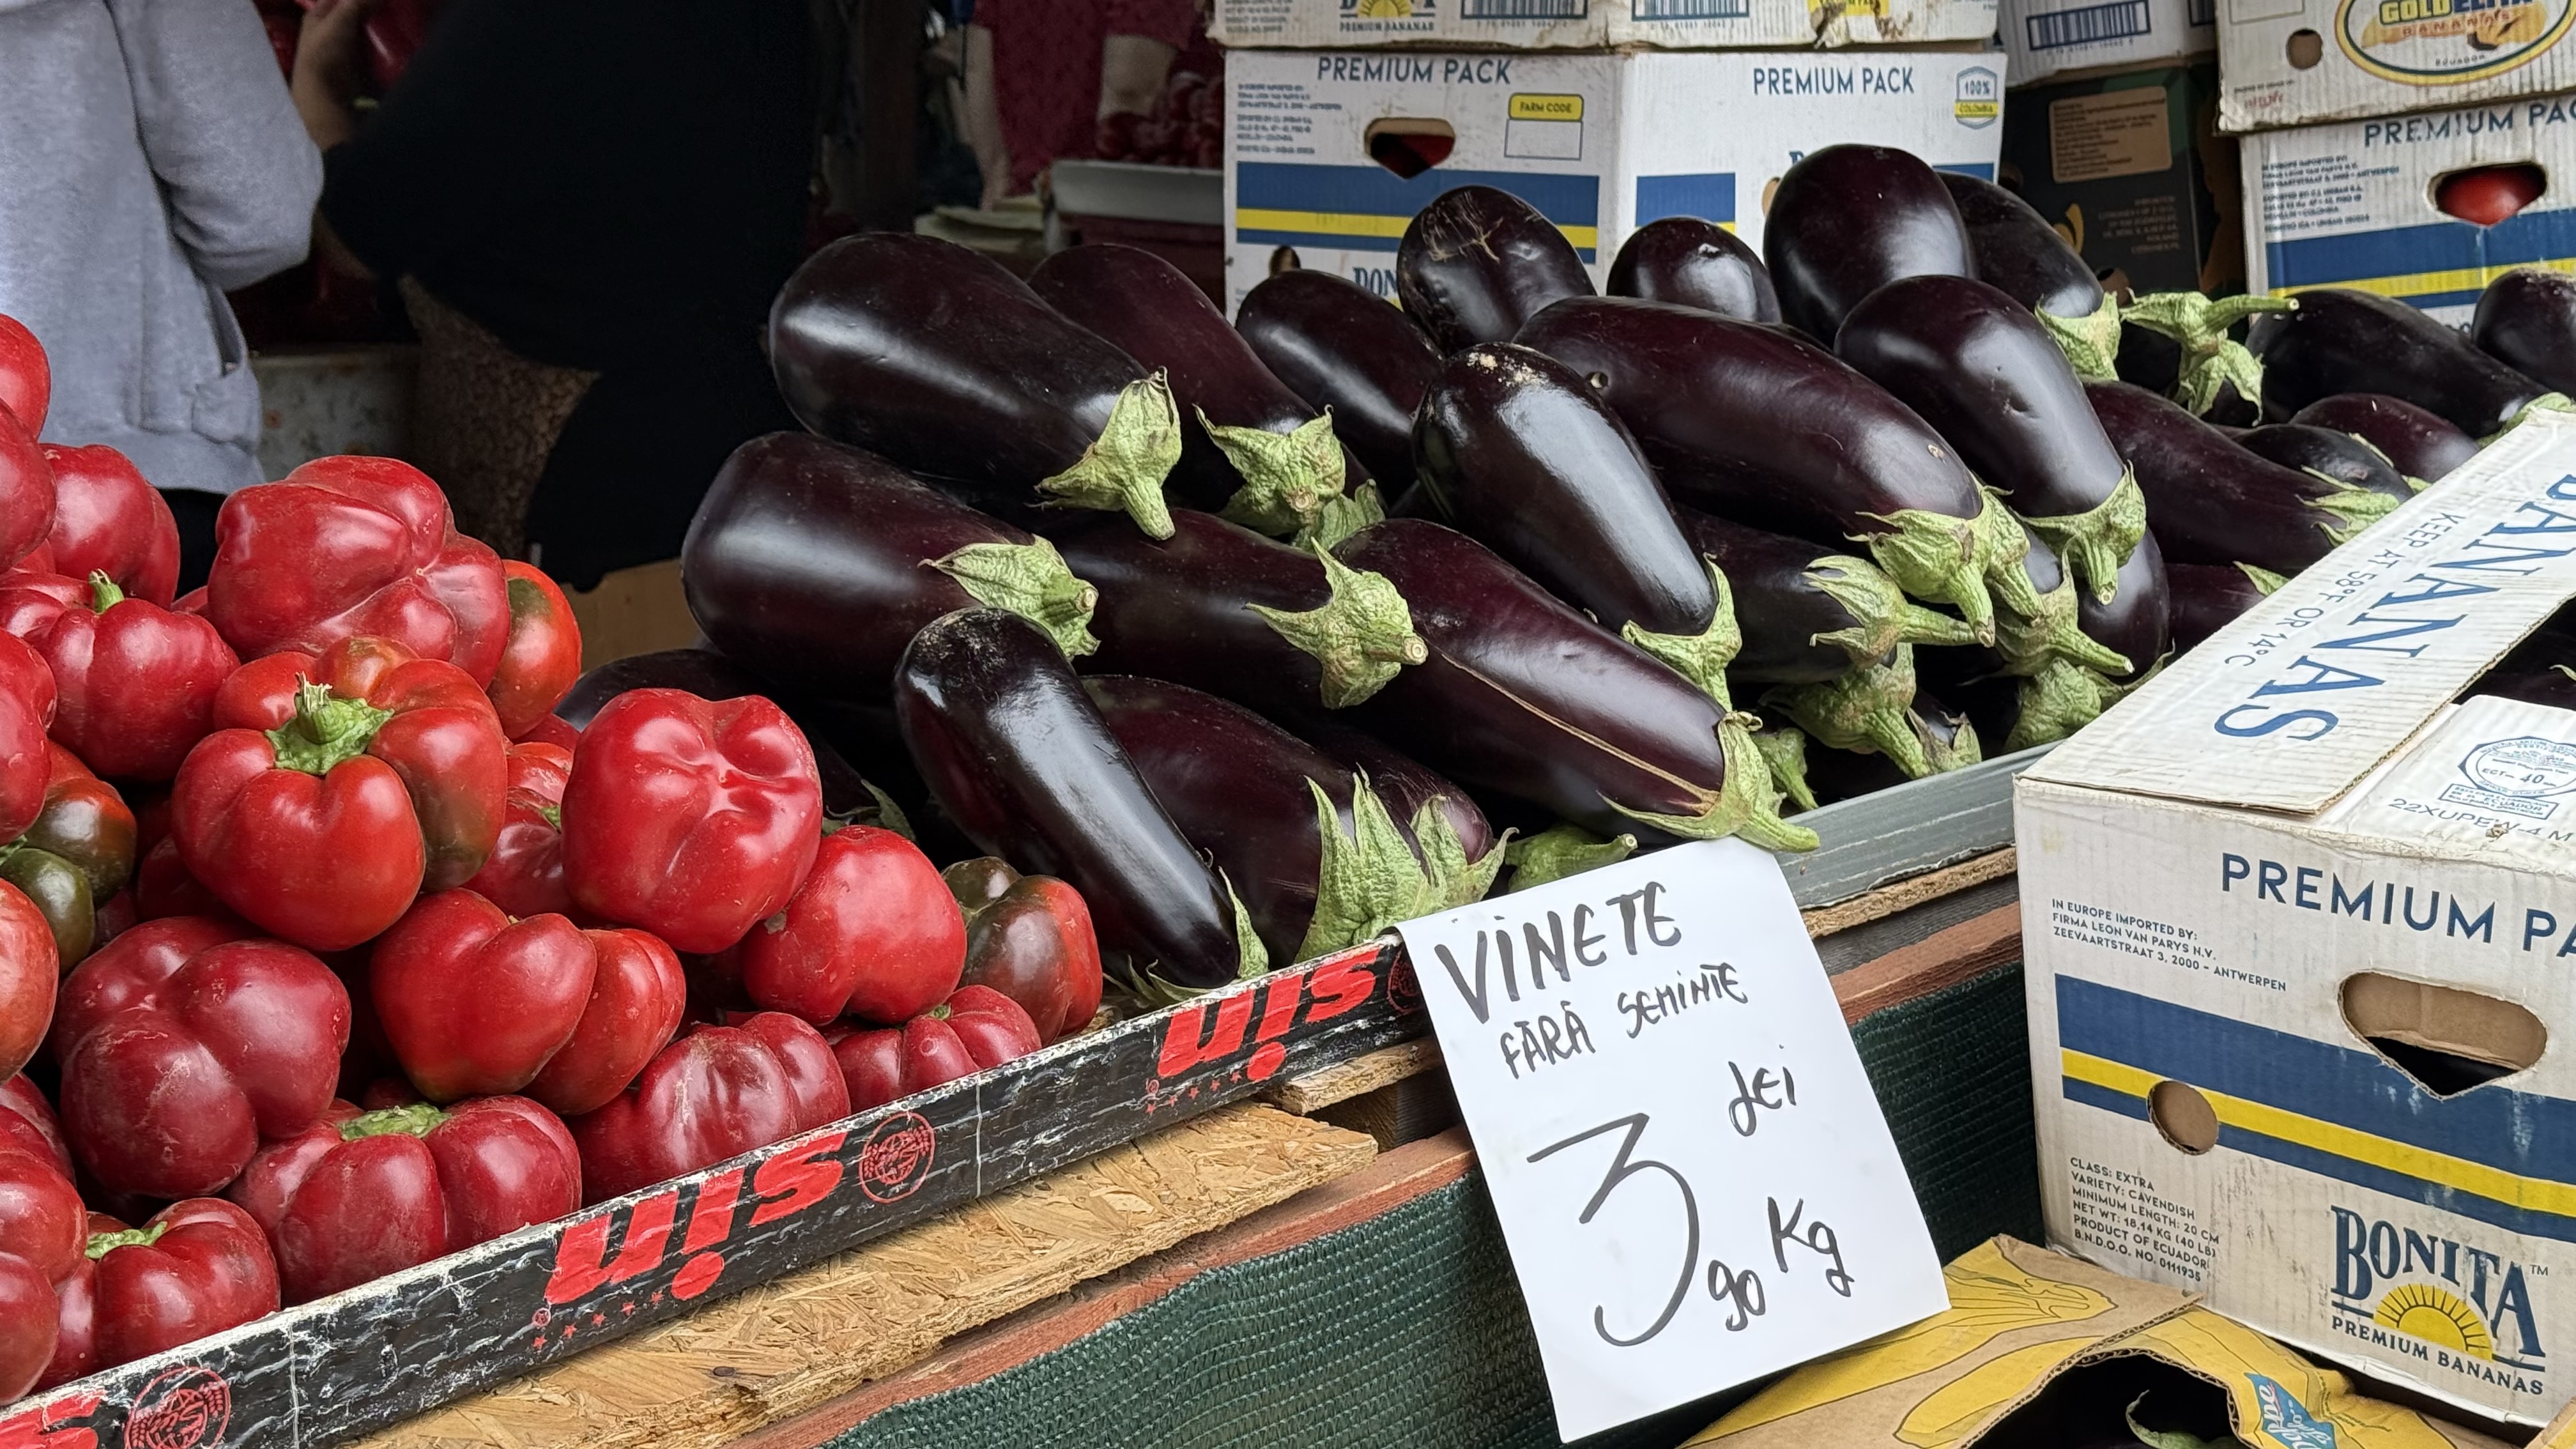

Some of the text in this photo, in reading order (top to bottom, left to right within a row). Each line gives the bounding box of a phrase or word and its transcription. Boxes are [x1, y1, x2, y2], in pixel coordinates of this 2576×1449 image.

[1317, 57, 1512, 85] PREMIUM PACK
[1753, 66, 1915, 95] PREMIUM PACK
[1964, 80, 1991, 95] 100%
[1520, 102, 1572, 113] FARM CODE
[2365, 107, 2513, 148] PREMIUM
[2403, 512, 2465, 548] KEEP
[2368, 549, 2405, 569] AT
[2276, 608, 2324, 628] OR
[2052, 898, 2198, 940] IN EUROPE IMPORTED BY:
[2222, 853, 2496, 944] PREMIUM
[1434, 881, 1682, 1024] VINETE
[2053, 912, 2217, 961] FIRMA LEON VAN PARYS N.V.
[2053, 926, 2154, 959] ZEEVAARTSTRAAT
[2172, 954, 2200, 970] 2000
[2214, 965, 2287, 992] ANTWERPEN
[2071, 1157, 2155, 1192] CLASS: EXTRA
[2071, 1170, 2195, 1220] VARIETY: CAVENDISH
[1526, 1112, 1700, 1347] 3
[2072, 1185, 2220, 1245] MINIMUM LENGTH: 20 CM
[2073, 1200, 2216, 1257] NET WT: 18.14 KG (40 LB)
[1768, 1197, 1855, 1298] Kg
[2074, 1214, 2207, 1270] PRODUCT OF ECUADOR
[2074, 1229, 2202, 1282] B.N.D.O.O. NO. 0111935
[2331, 1204, 2546, 1358] BONITA
[2332, 1315, 2543, 1395] PREMIUM BANANAS
